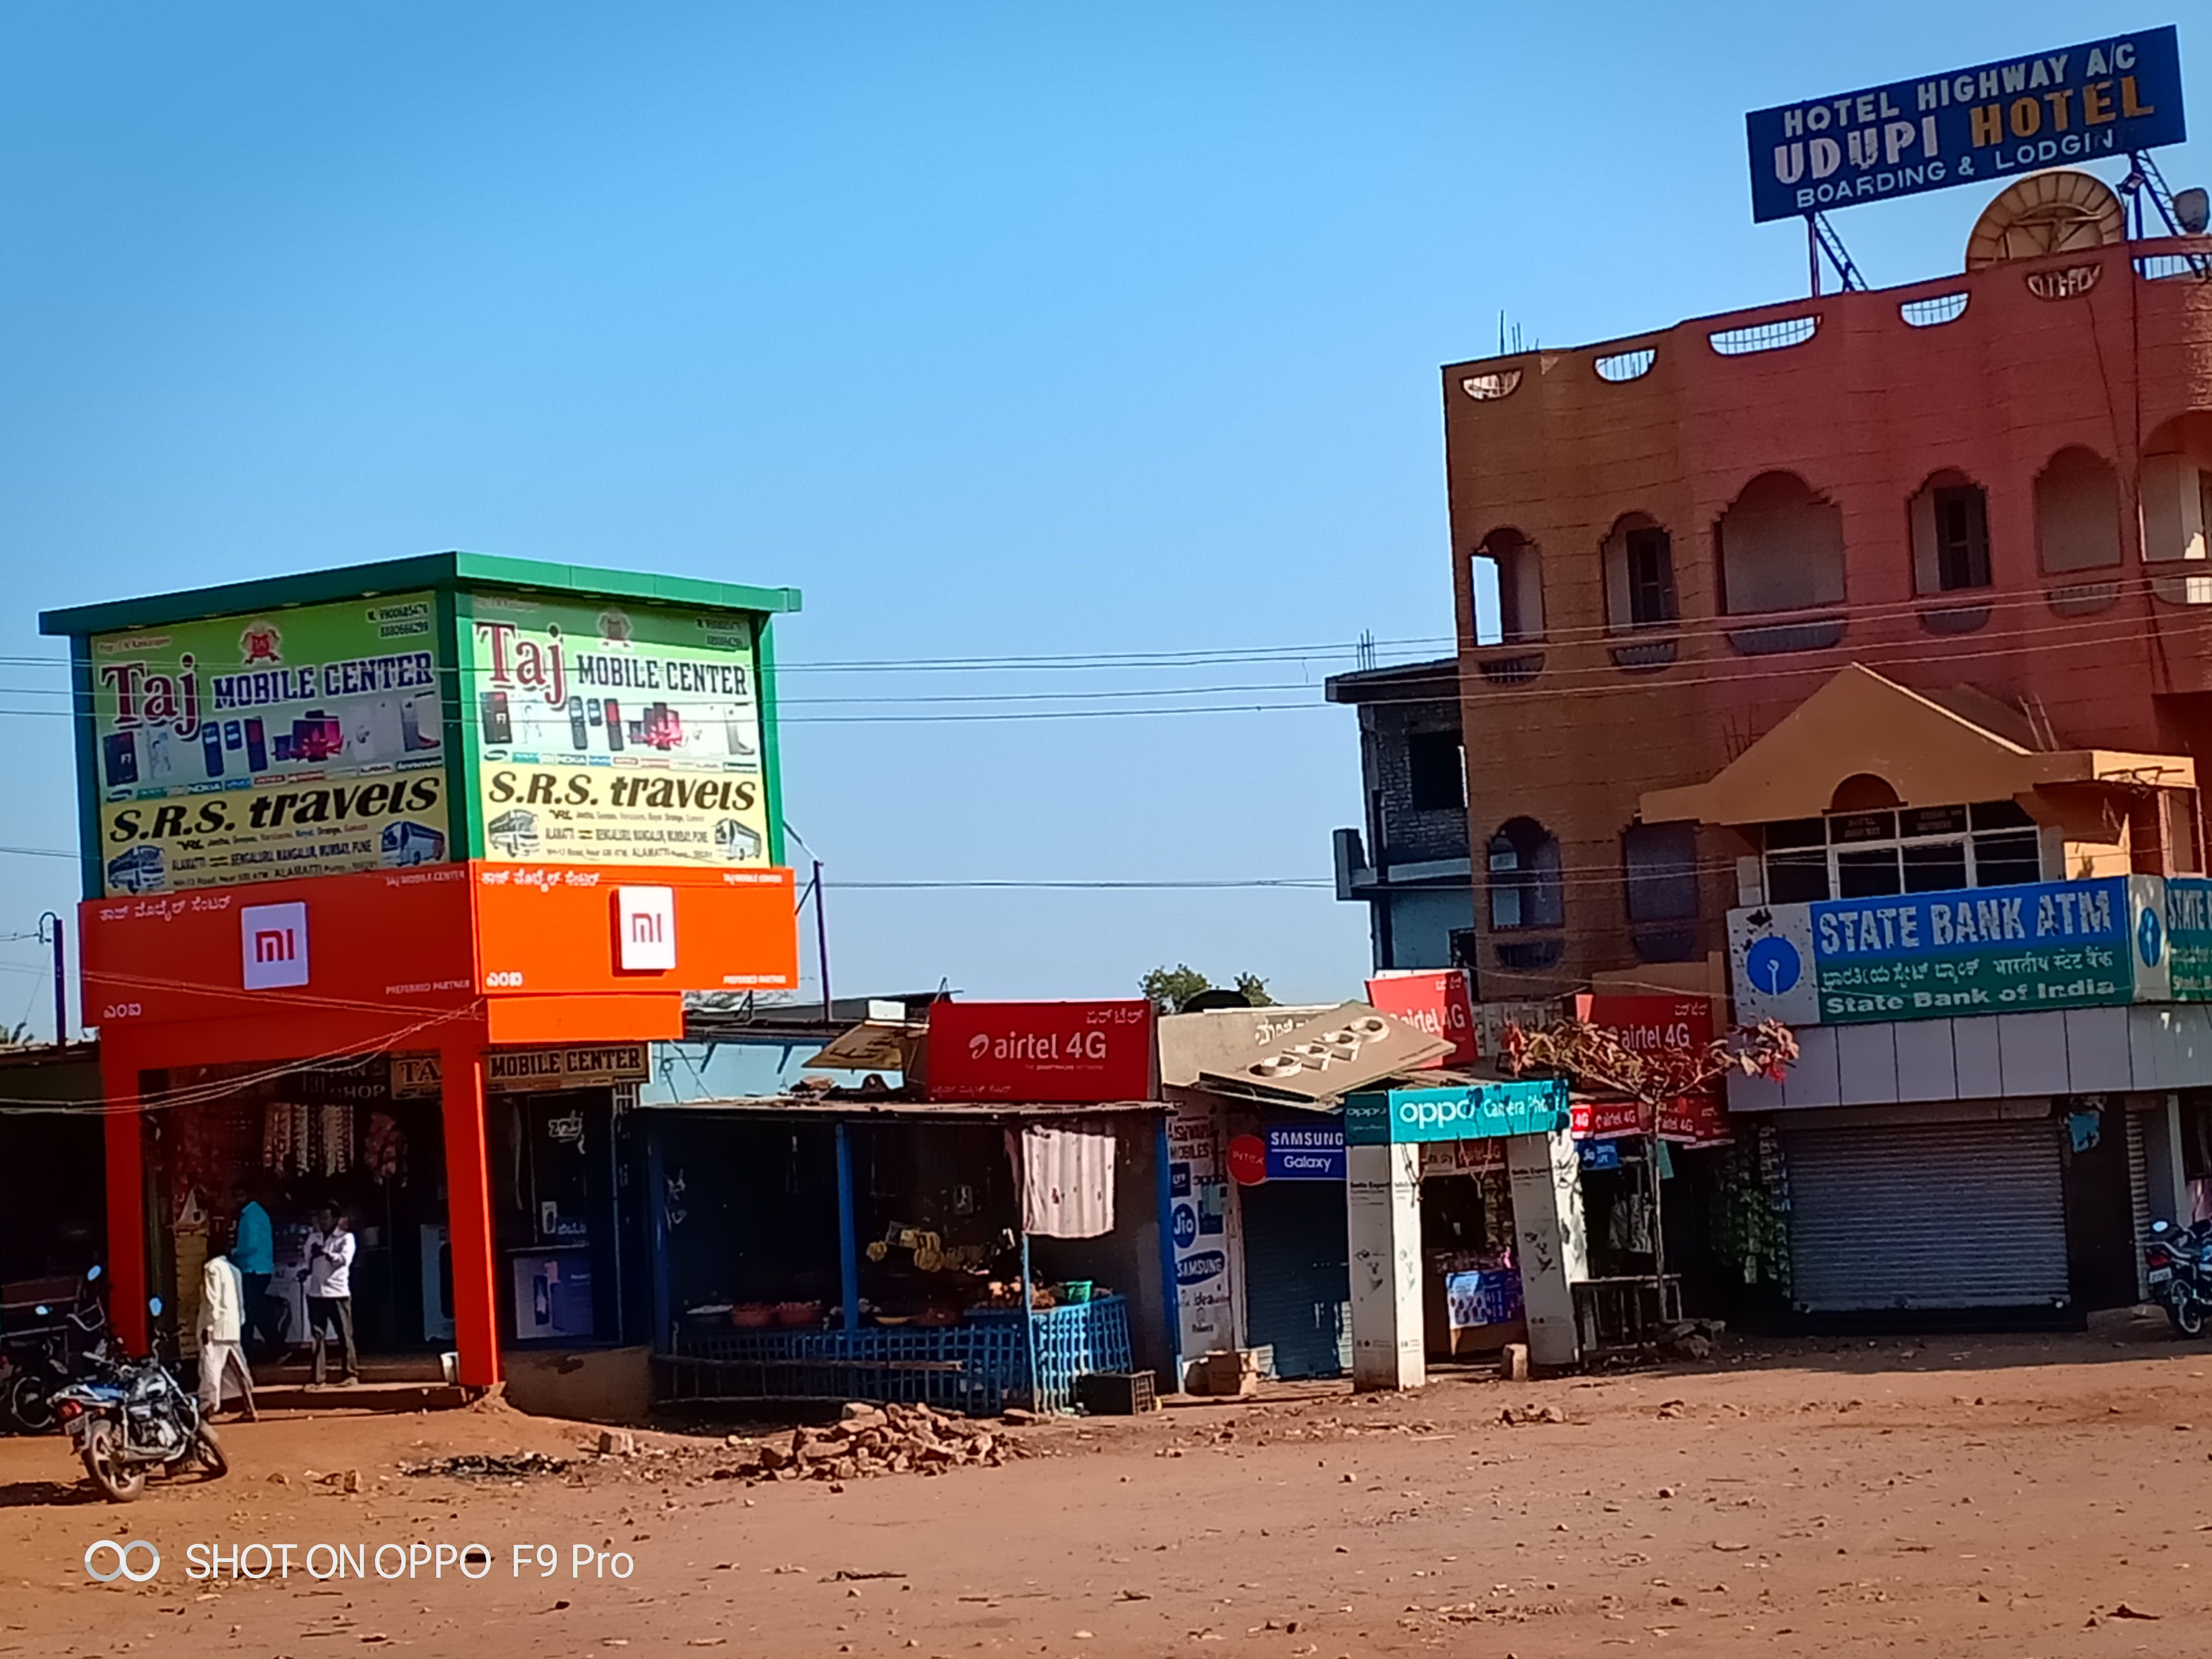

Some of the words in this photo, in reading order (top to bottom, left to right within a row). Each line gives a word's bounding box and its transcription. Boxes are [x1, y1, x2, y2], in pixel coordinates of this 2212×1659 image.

[1784, 92, 1899, 138] HOTEL
[1917, 55, 2070, 109] HIGHWAY
[2086, 42, 2137, 76] A/C
[1774, 116, 1938, 185] UDUPI
[1970, 75, 2155, 148] HOTEL
[1796, 156, 1947, 208] BOARDING
[1958, 156, 1975, 176] &
[476, 622, 566, 706] Taj
[576, 653, 660, 689] MOBILE
[666, 661, 748, 695] CENTER
[101, 653, 200, 741] Taj
[213, 668, 315, 709] MOBILE
[324, 652, 434, 696] CENTER
[489, 770, 598, 805] S.R.S.
[610, 774, 756, 811] travels
[109, 800, 235, 842] S.R.S.
[249, 777, 440, 829] travels
[1819, 905, 1920, 955] STATE
[1930, 897, 2025, 946] BANK
[2037, 889, 2112, 937] ATM
[2167, 889, 2205, 930] STATE
[1993, 951, 2050, 975] भारतीय
[2053, 948, 2083, 971] स्टेट
[2085, 945, 2113, 968] बैंक
[1826, 994, 1905, 1014] State
[1913, 987, 1992, 1008] Bank
[1998, 984, 2028, 1002] of
[2037, 978, 2115, 999] India
[994, 1031, 1059, 1059] airtel
[1065, 1031, 1106, 1059] 4G
[1621, 1023, 1661, 1049] airtel
[1665, 1022, 1693, 1049] 4G
[398, 1058, 443, 1085] TA
[491, 1052, 561, 1078] MOBILE
[566, 1048, 641, 1073] CENTER
[1399, 1102, 1475, 1129] oppo
[1575, 1112, 1589, 1127] 4G
[1623, 1110, 1636, 1123] 4G
[1680, 1118, 1694, 1132] 4G
[1271, 1131, 1344, 1146] SAMSUNG
[1283, 1155, 1332, 1173] Galaxy
[1173, 1211, 1194, 1235] Jio
